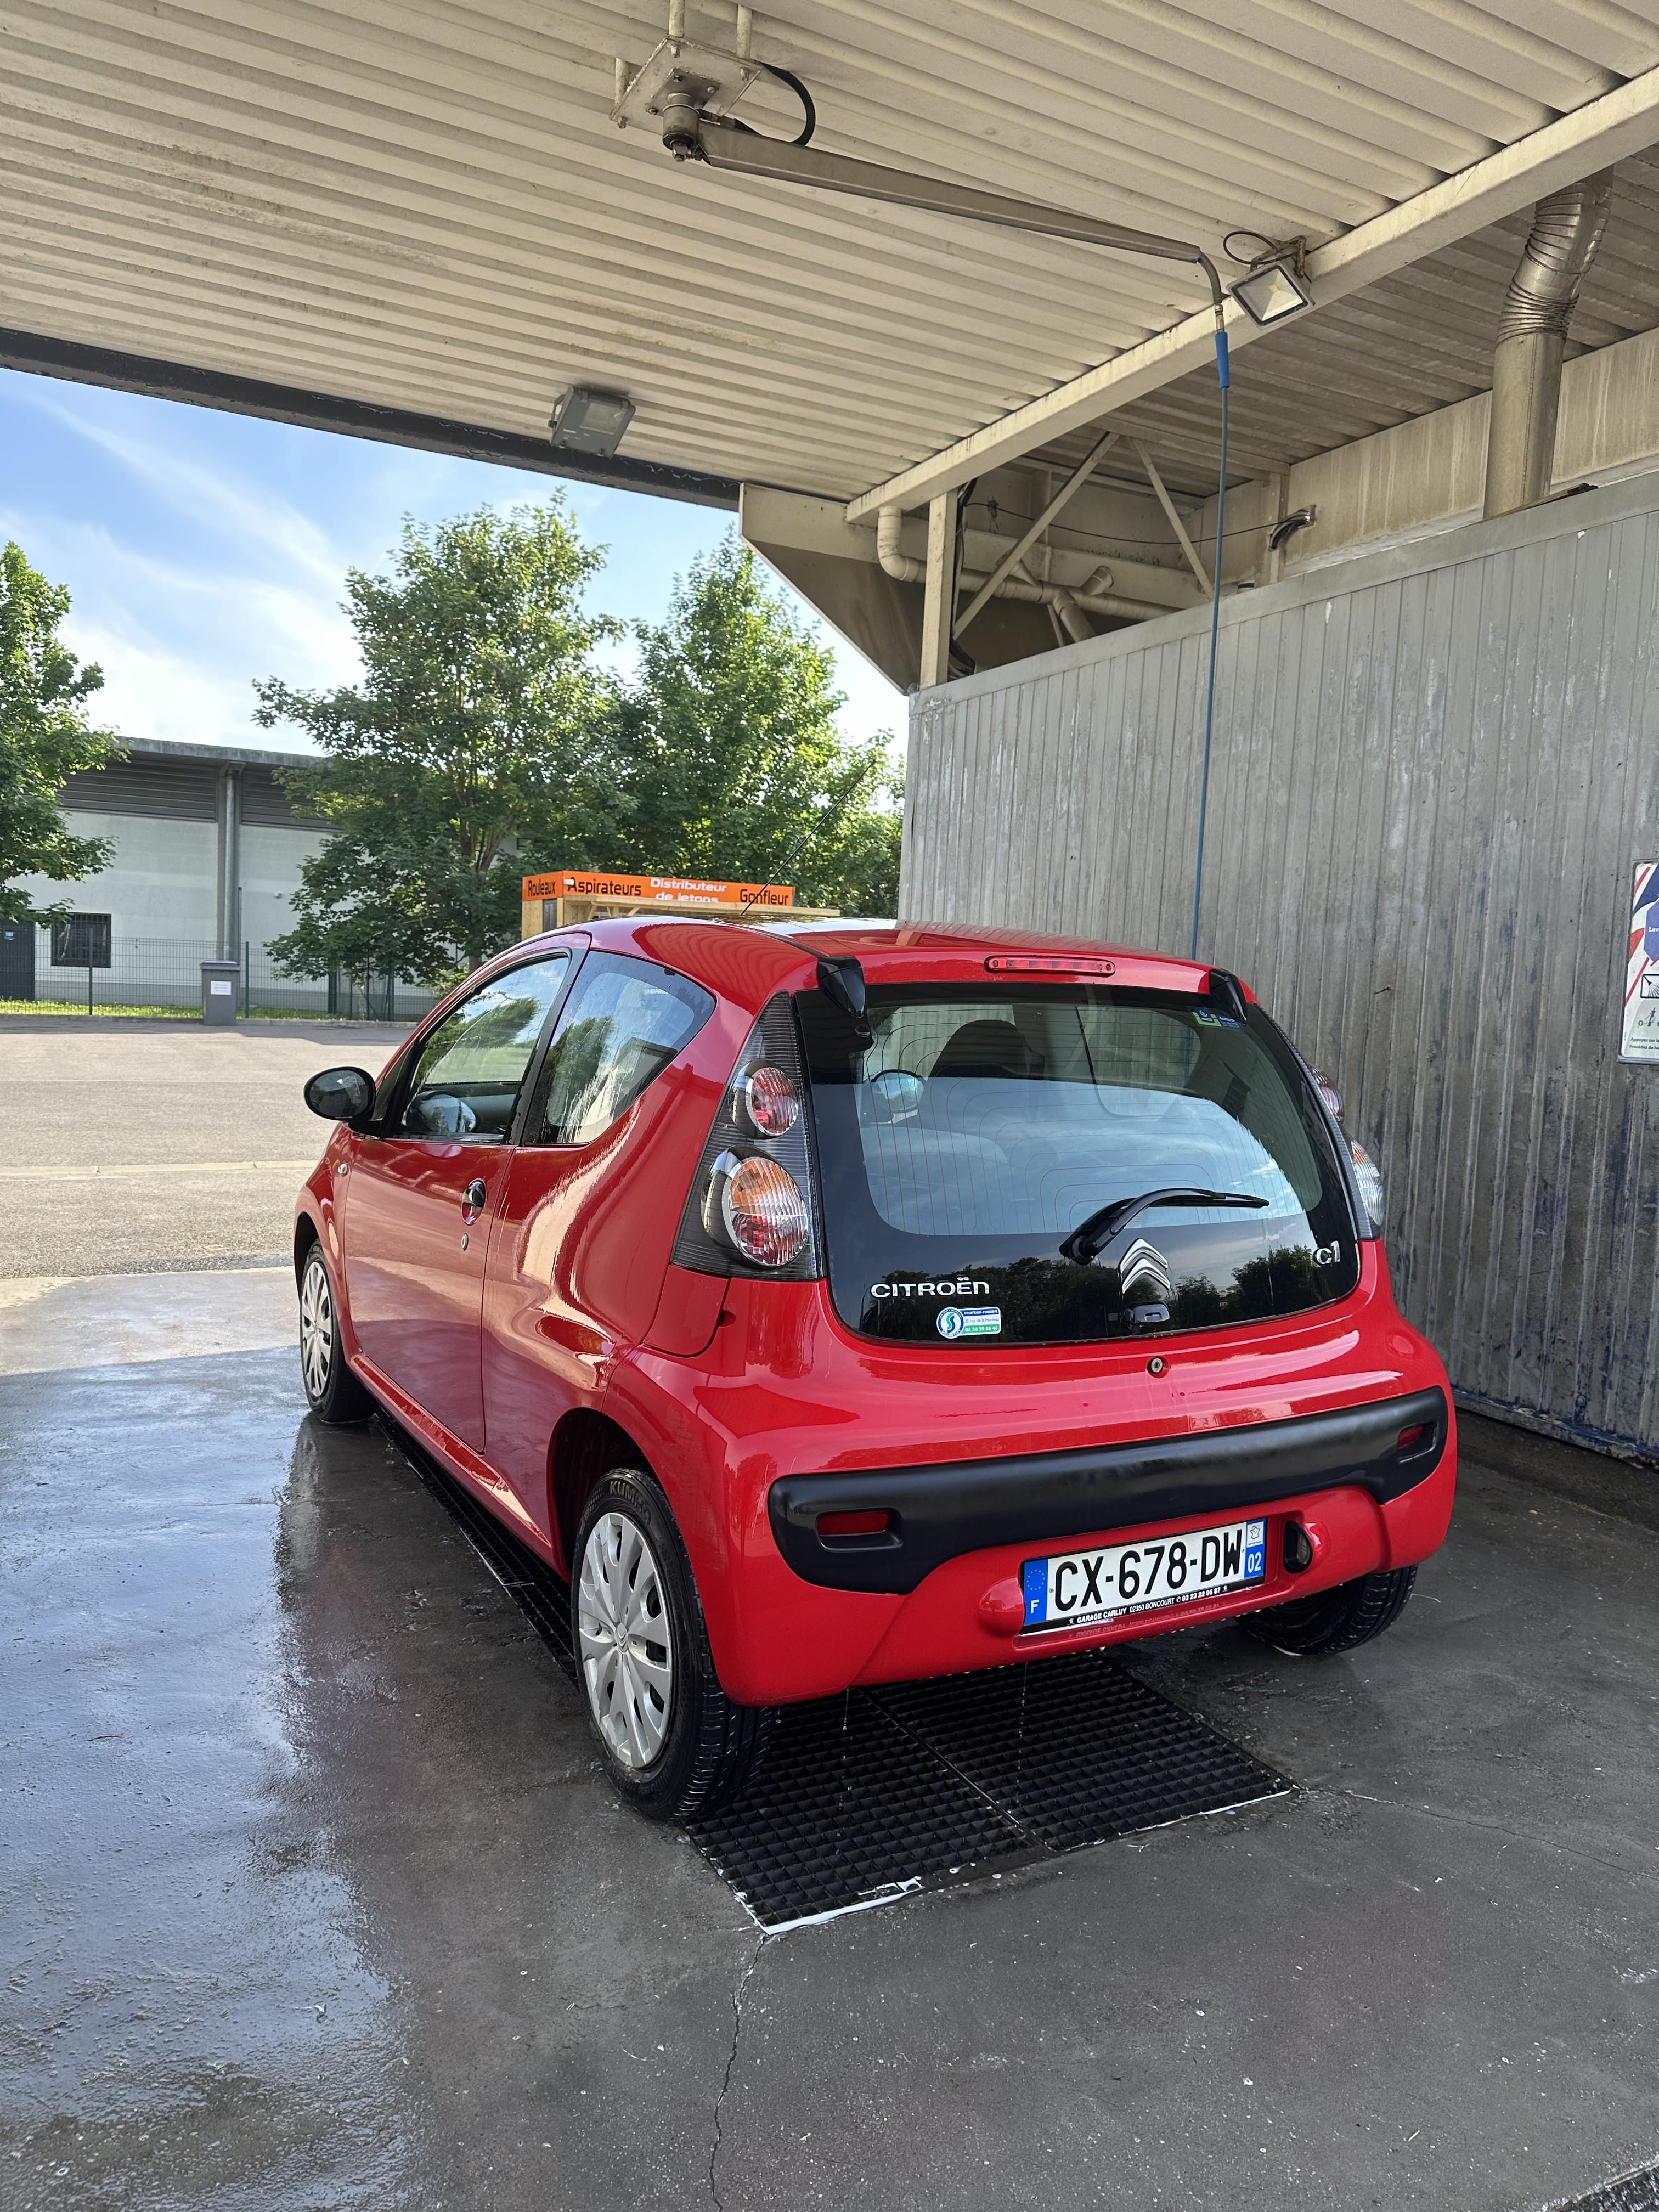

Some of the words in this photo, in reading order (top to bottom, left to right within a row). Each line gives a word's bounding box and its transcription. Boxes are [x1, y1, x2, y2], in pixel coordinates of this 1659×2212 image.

[528, 880, 555, 897] Rouleaux
[567, 877, 641, 896] Aspirateurs
[650, 878, 727, 893] Distributeur
[655, 891, 673, 900] de
[740, 889, 788, 905] Gonfleur
[610, 1481, 652, 1525] KUMHO
[1055, 1529, 1242, 1611] CX-678-DW
[1248, 1551, 1262, 1573] 02
[1030, 1599, 1040, 1614] F
[1077, 1612, 1102, 1623] GARAGE
[1103, 1607, 1127, 1618] CARLUY
[1145, 1597, 1175, 1610] BONCOURT
